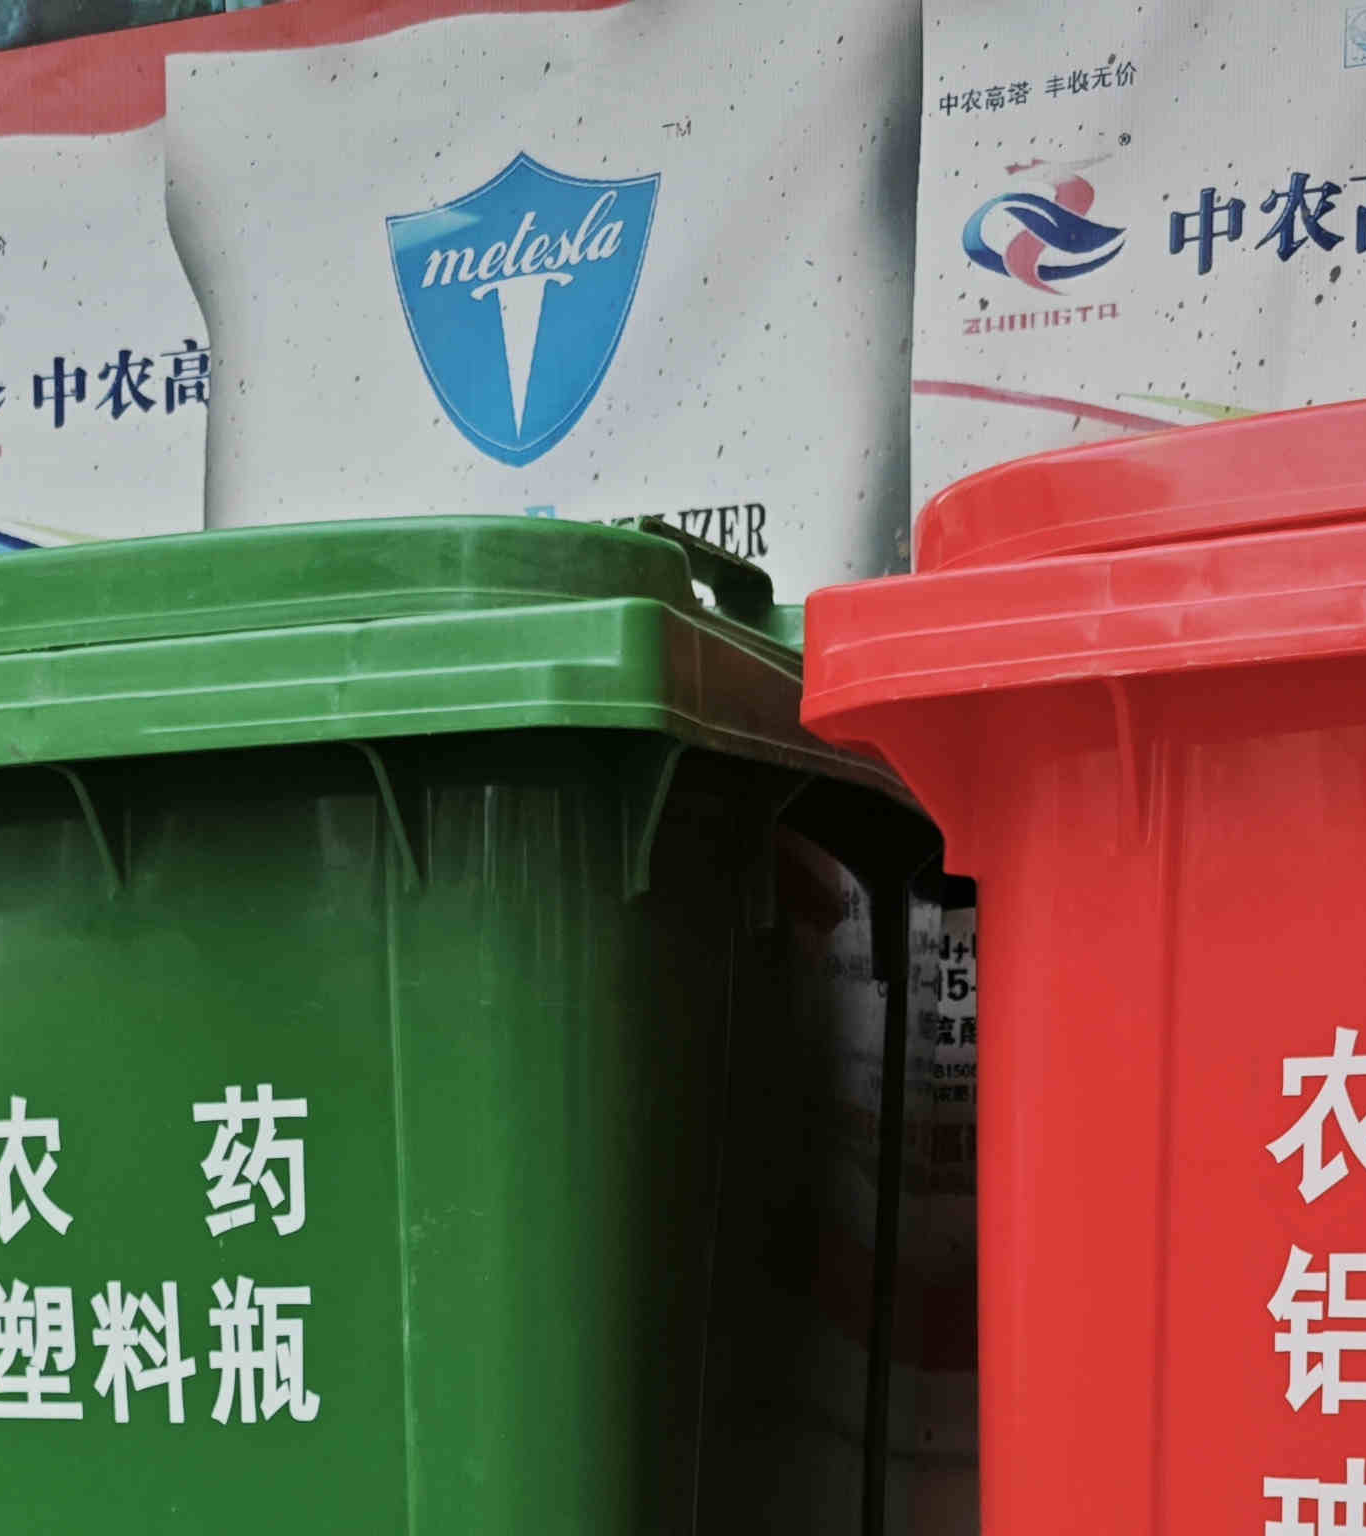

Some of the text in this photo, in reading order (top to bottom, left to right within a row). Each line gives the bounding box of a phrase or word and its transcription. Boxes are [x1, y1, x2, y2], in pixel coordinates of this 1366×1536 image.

[939, 61, 1137, 116] 中农高塔 丰收无价
[662, 120, 692, 138] TM
[420, 189, 624, 289] metesla
